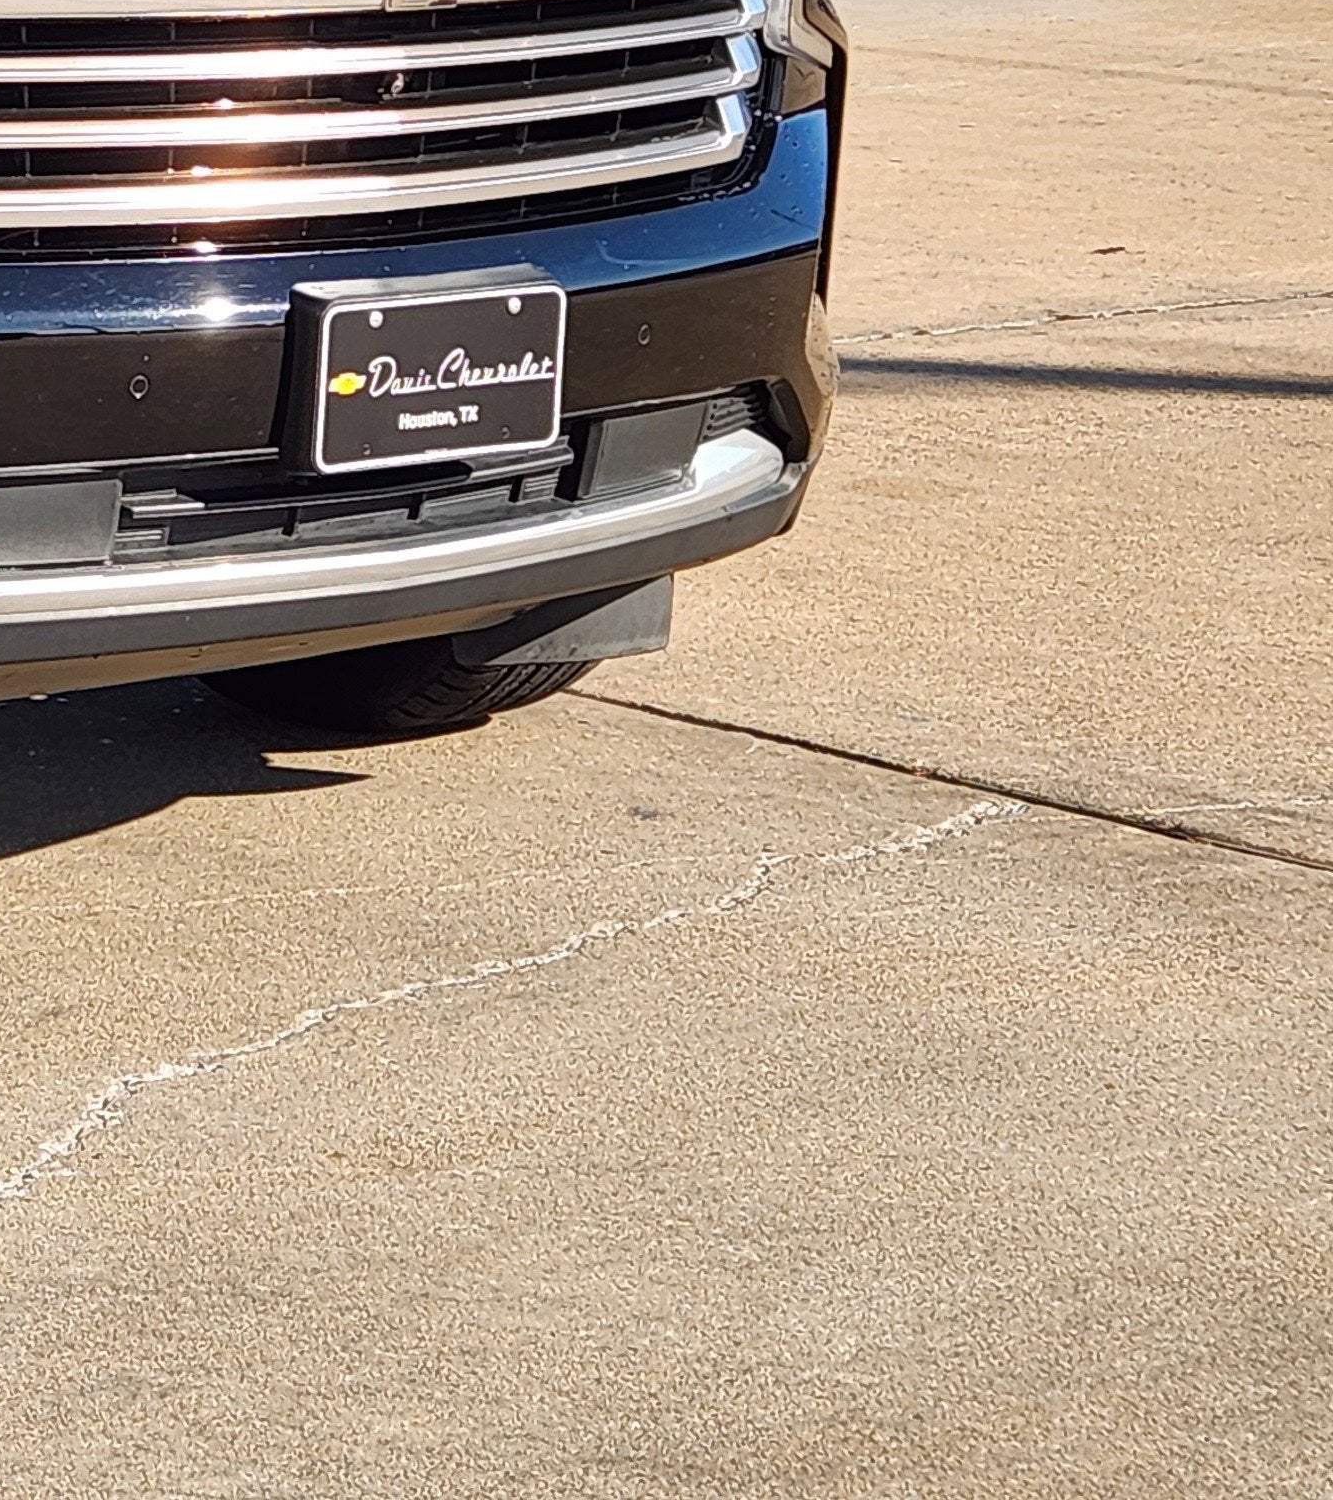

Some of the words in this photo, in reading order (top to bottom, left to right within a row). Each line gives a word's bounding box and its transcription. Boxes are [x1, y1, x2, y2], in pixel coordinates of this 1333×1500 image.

[368, 356, 437, 397] Davis
[437, 348, 555, 390] Chevrolet
[398, 411, 457, 431] Houston,
[458, 405, 480, 423] TX
